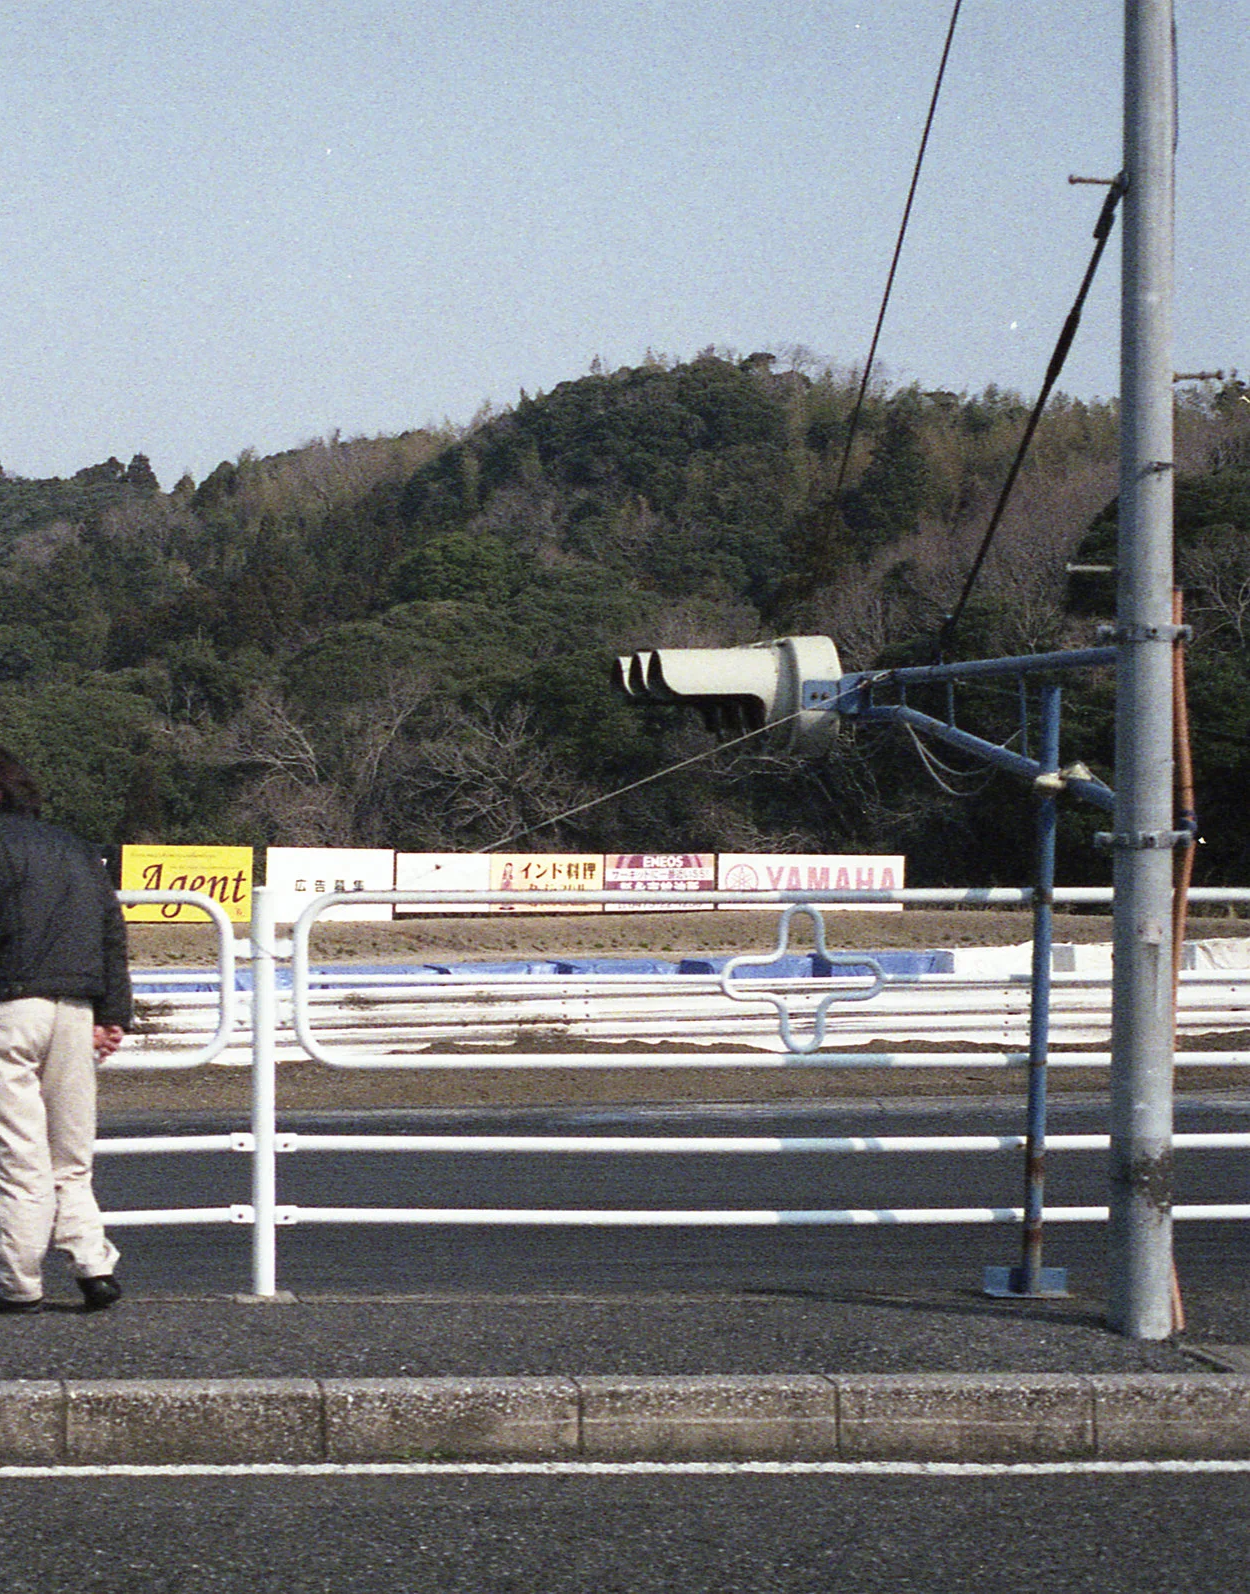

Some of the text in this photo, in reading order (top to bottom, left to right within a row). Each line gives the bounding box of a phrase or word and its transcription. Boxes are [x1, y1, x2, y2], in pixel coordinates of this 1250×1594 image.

[521, 862, 597, 880] インド料理
[642, 855, 684, 868] ENEOS
[766, 865, 896, 890] YAMAHA
[126, 863, 247, 918] Agent
